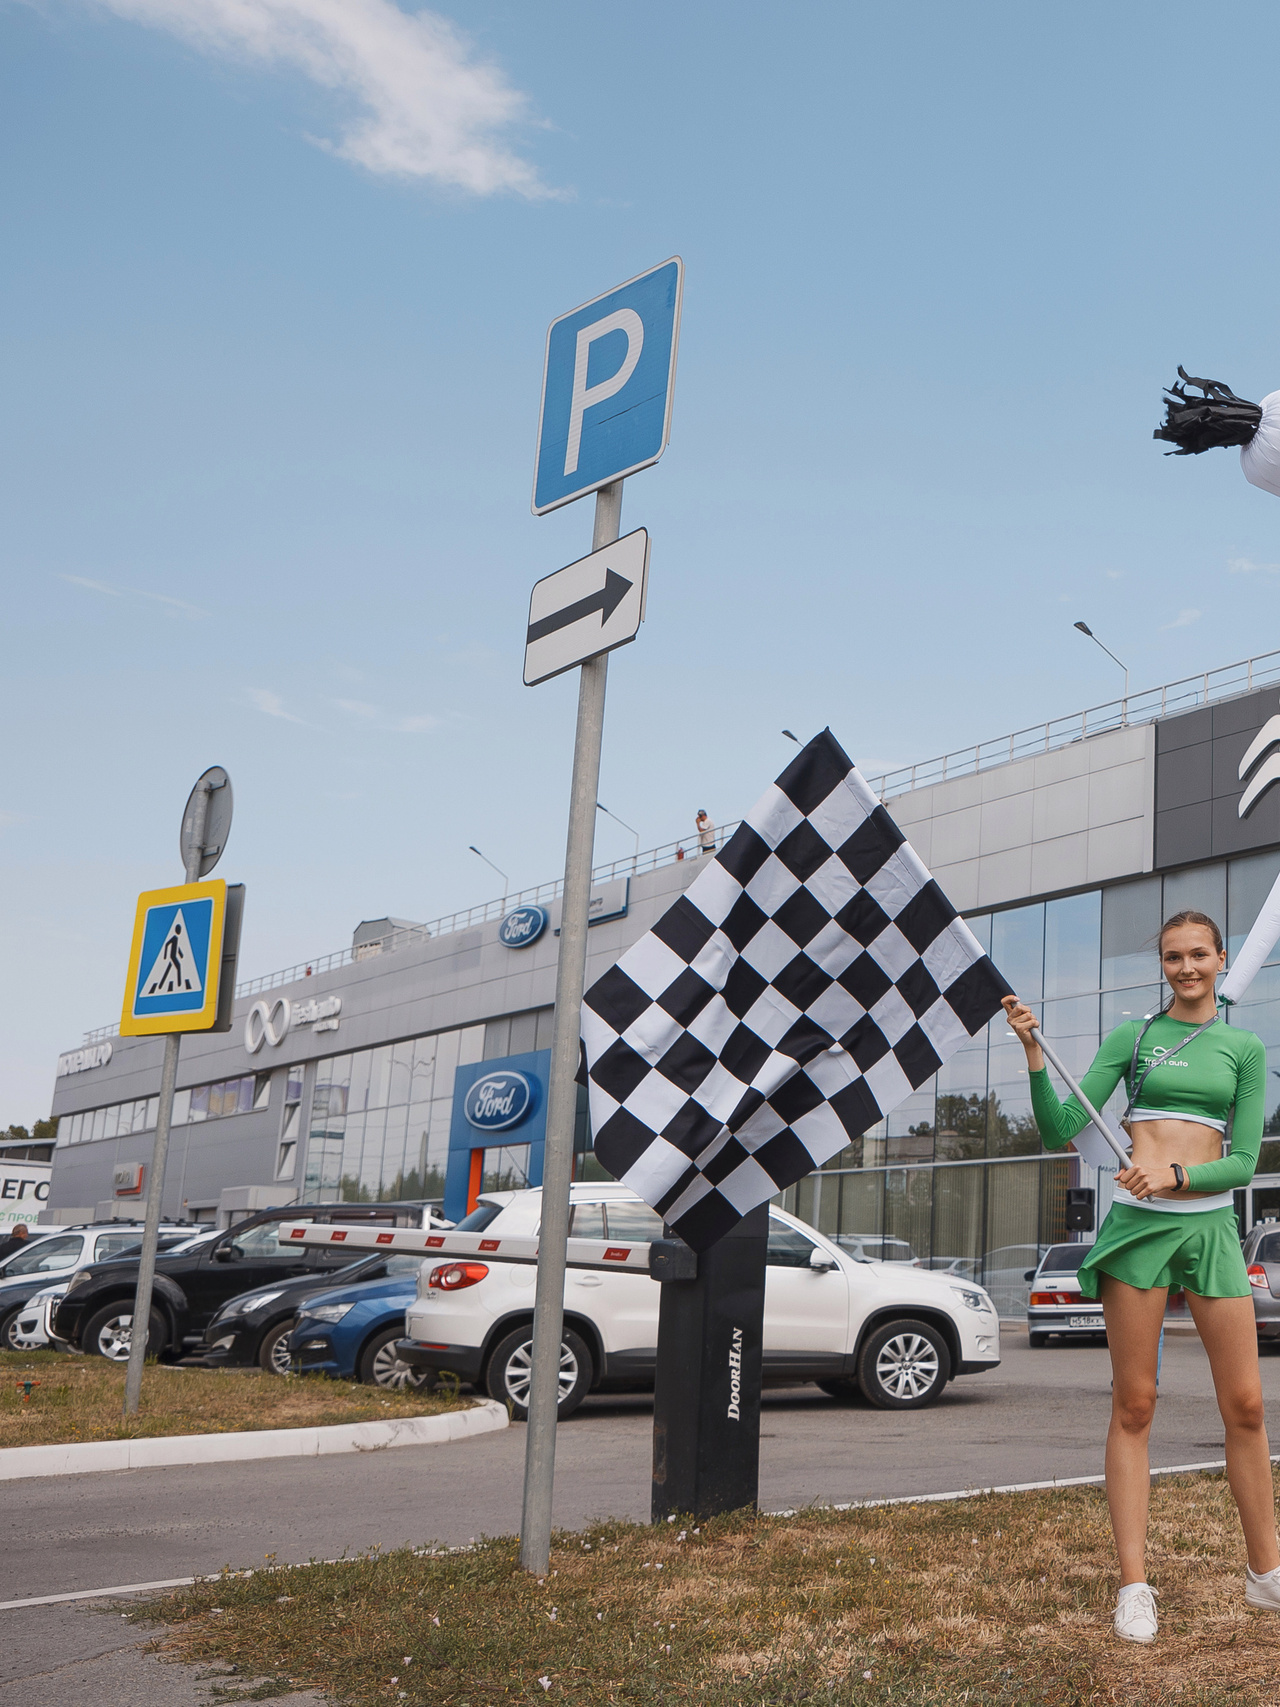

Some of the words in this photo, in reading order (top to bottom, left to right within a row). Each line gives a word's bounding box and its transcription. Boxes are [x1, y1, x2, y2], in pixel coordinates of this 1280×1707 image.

[564, 308, 644, 477] P
[504, 912, 534, 940] Ford
[474, 1080, 517, 1119] Ford
[0, 1178, 51, 1201] ЕГО
